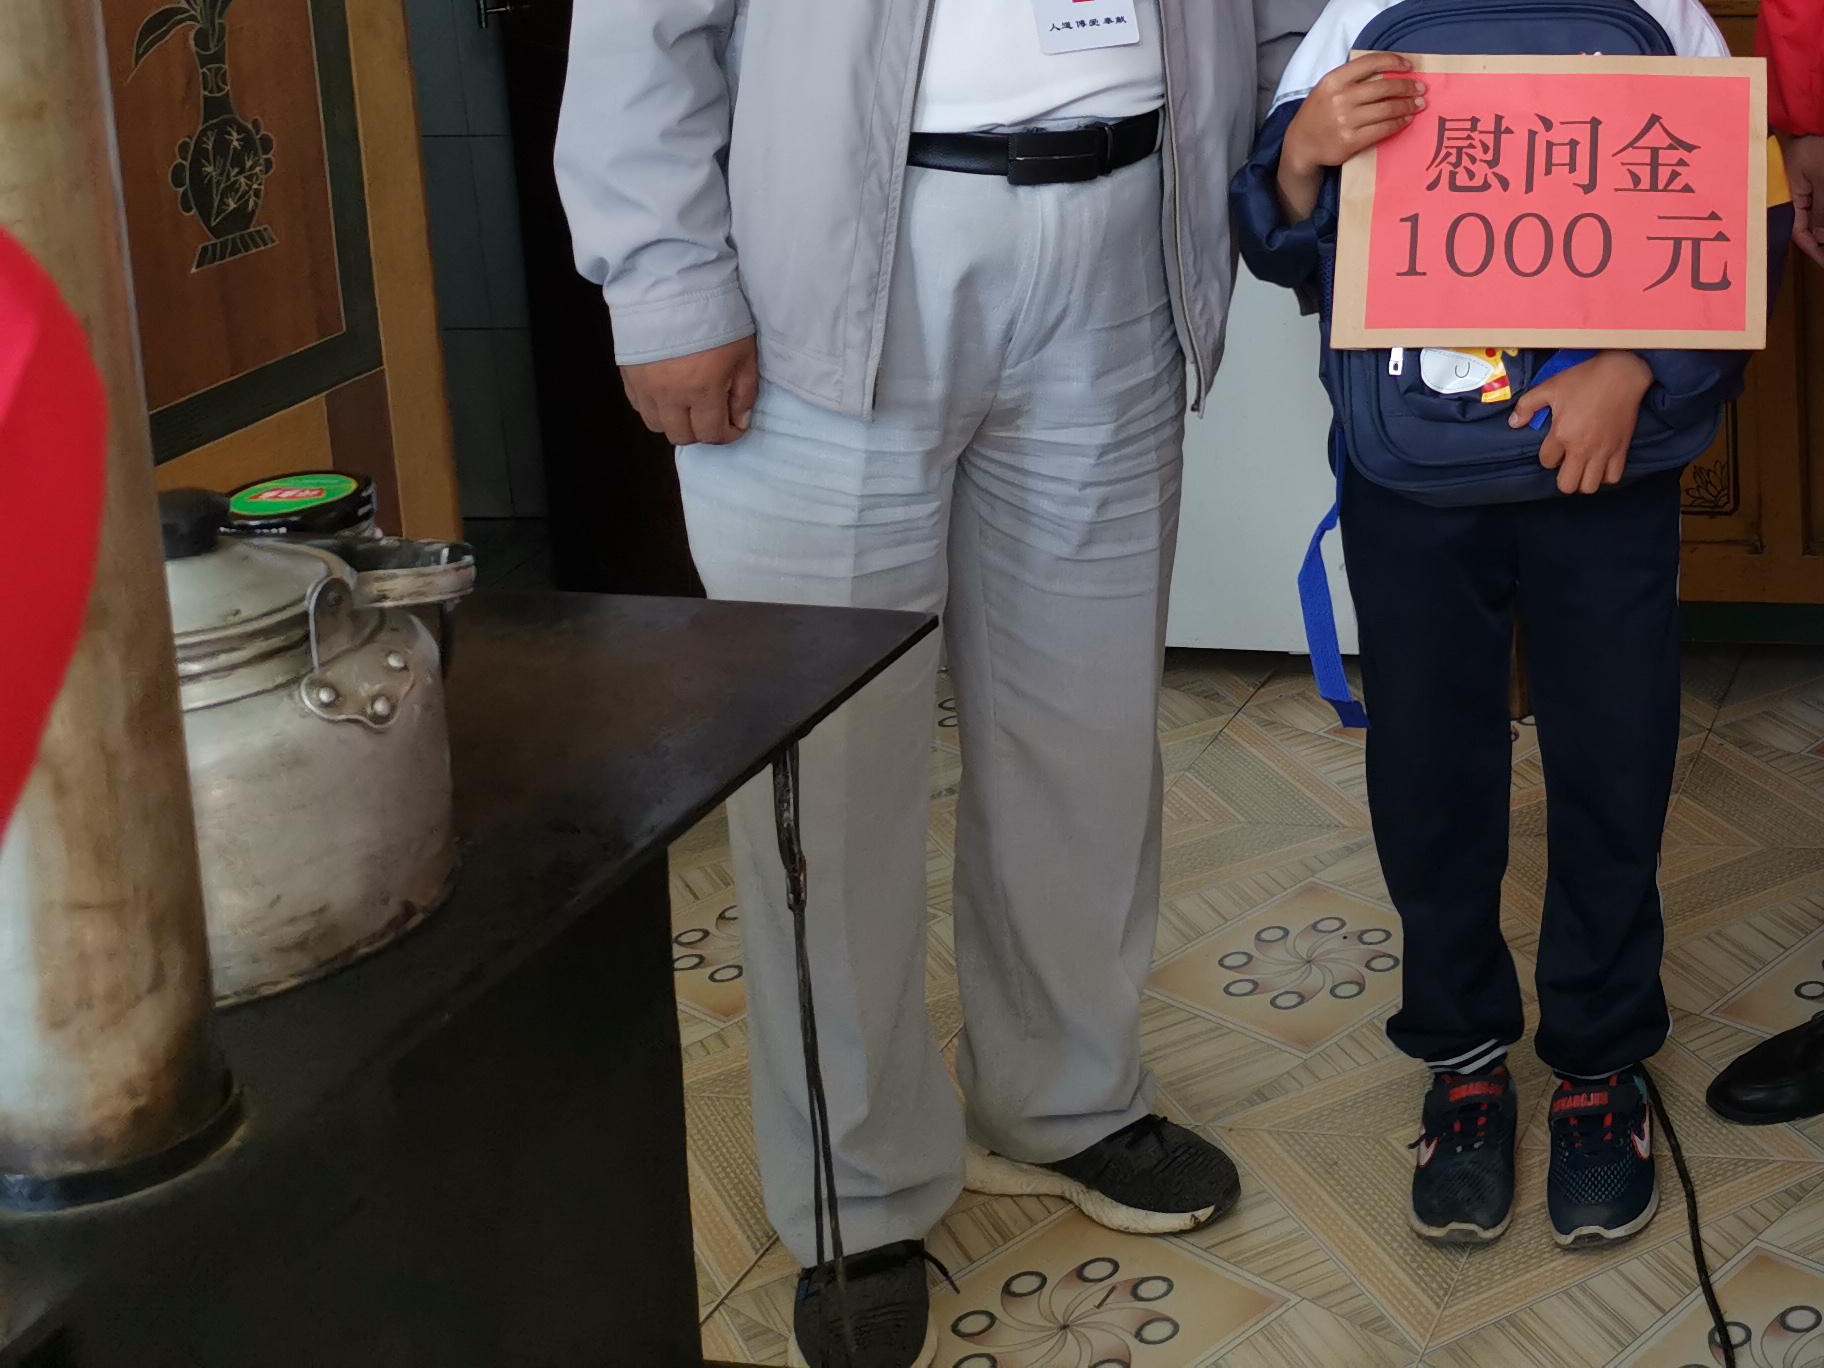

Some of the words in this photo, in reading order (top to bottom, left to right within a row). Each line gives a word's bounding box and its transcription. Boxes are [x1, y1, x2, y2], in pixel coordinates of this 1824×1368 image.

[1425, 113, 1701, 195] 慰问金
[1395, 212, 1613, 278] 1000
[1642, 210, 1732, 292] 元
